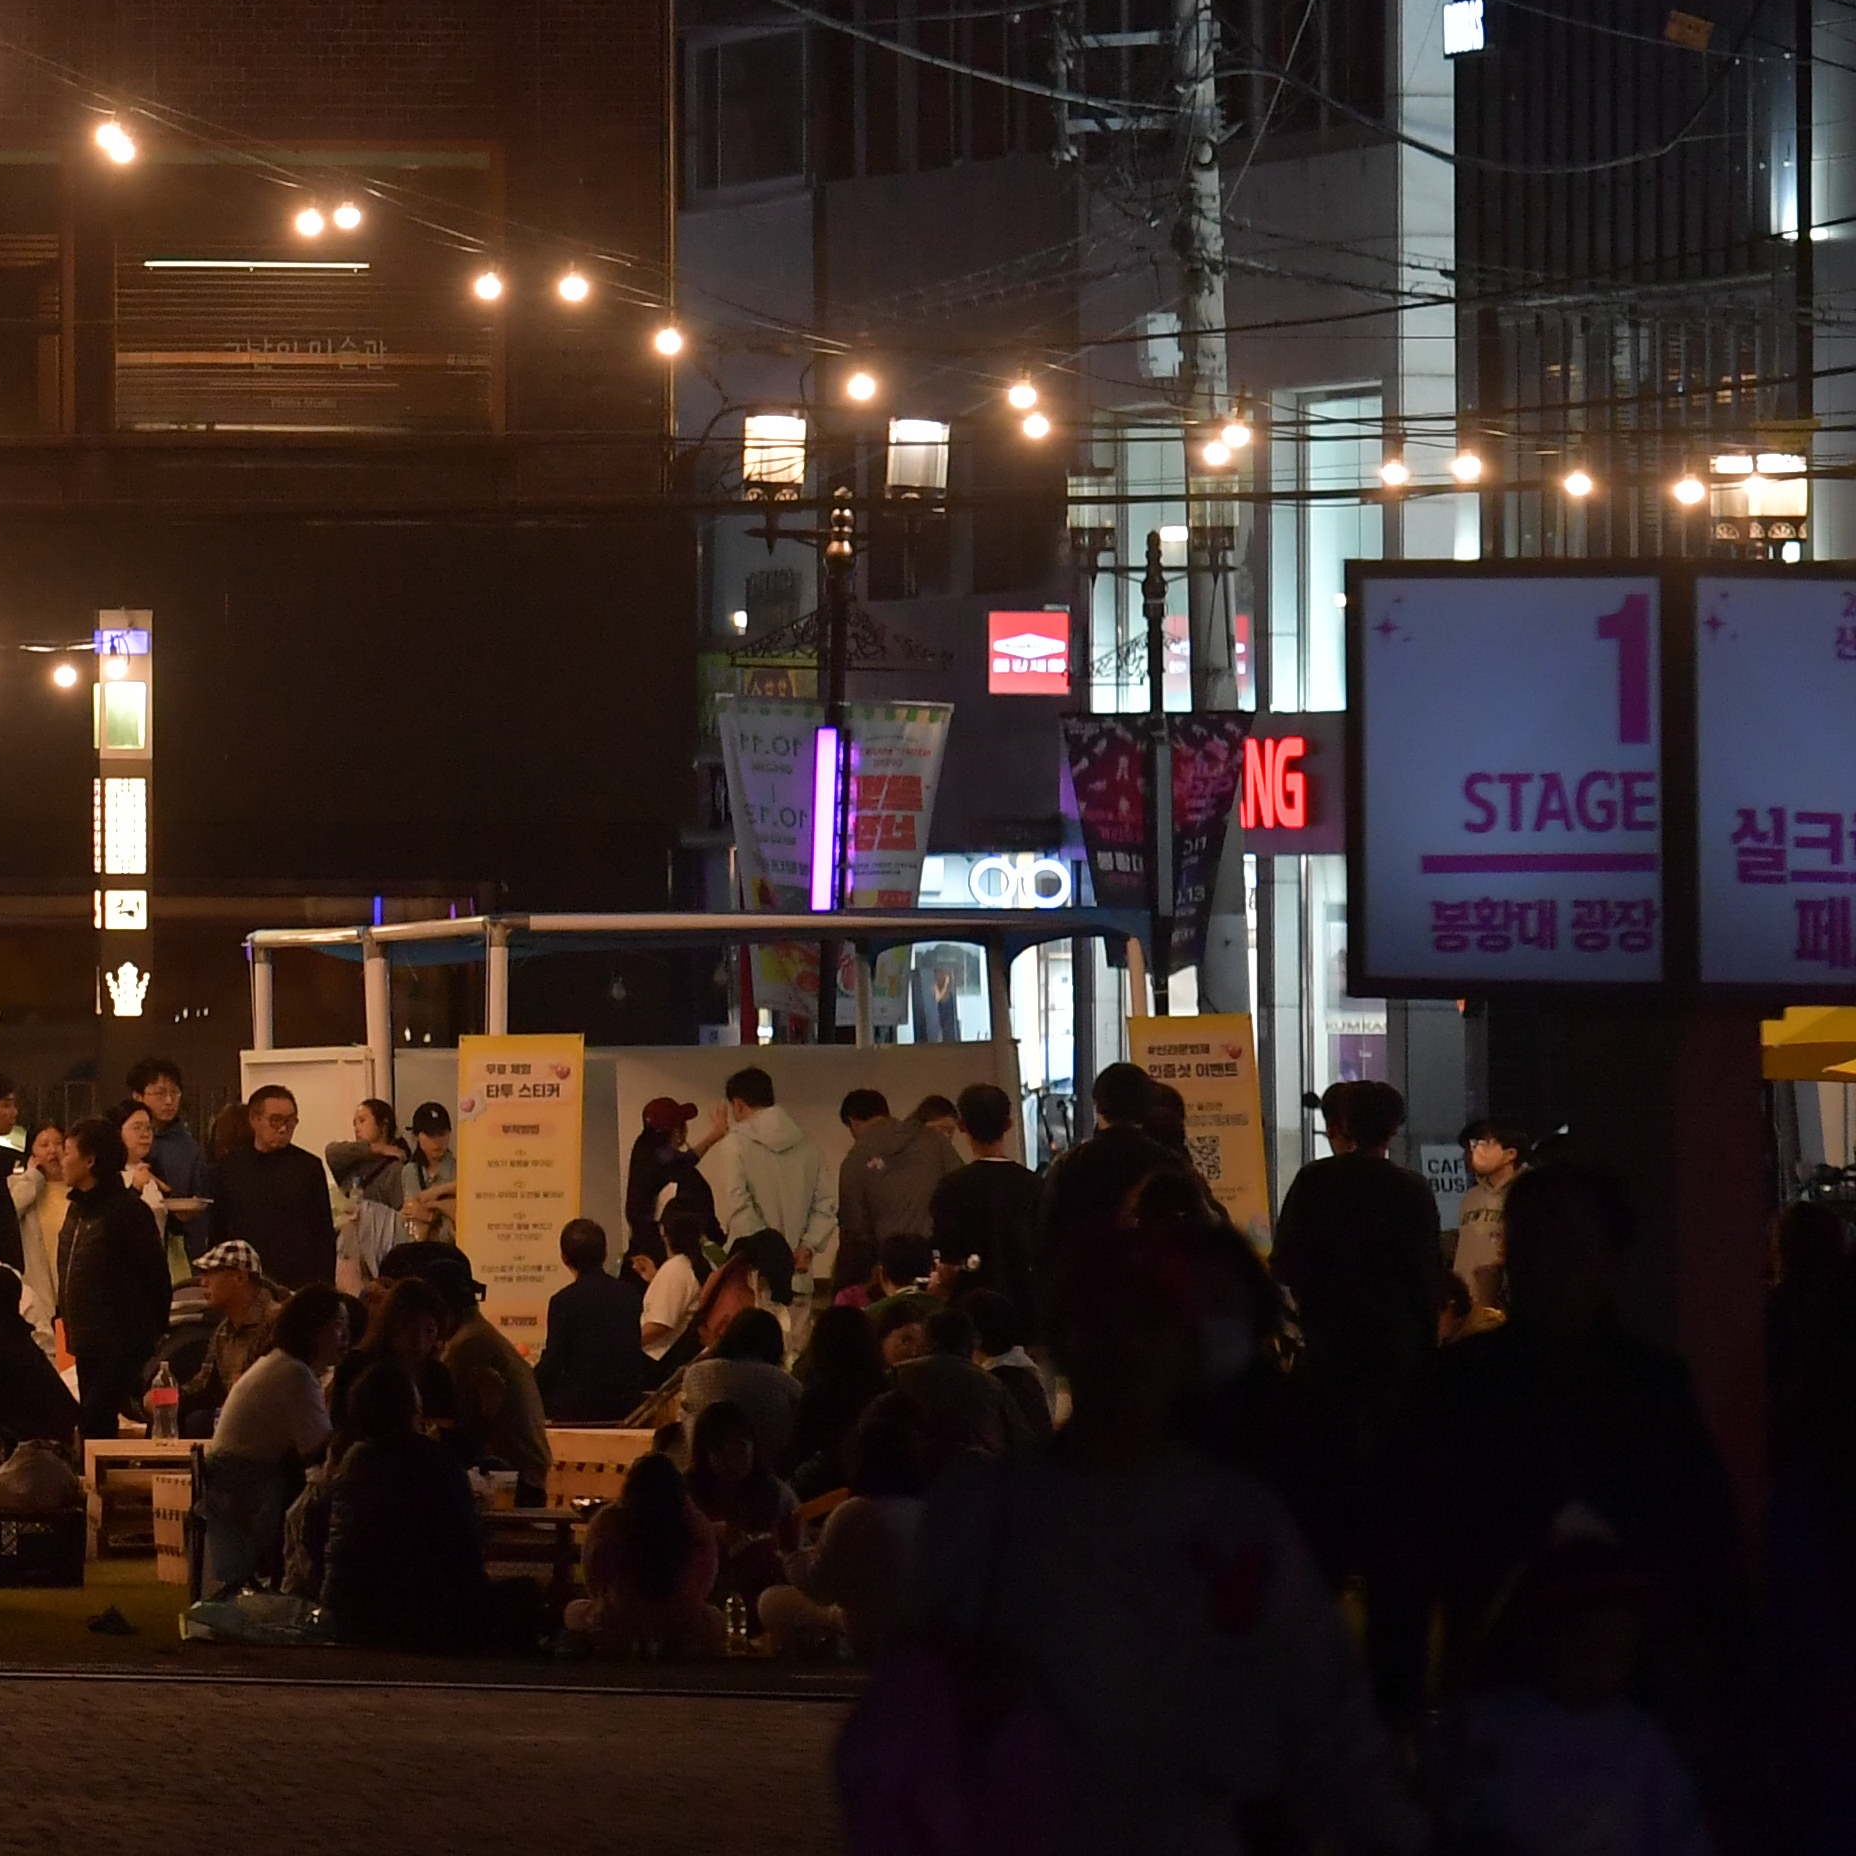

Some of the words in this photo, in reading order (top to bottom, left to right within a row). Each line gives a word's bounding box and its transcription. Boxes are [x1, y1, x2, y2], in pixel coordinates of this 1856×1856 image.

[1598, 593, 1650, 744] 1
[1240, 736, 1306, 830] NG
[1464, 770, 1656, 834] STAGE
[1732, 806, 1856, 885] 실크
[1431, 898, 1558, 954] 봉황대
[1571, 898, 1656, 954] 광장
[1795, 895, 1856, 969] 페
[1325, 1020, 1387, 1033] KUMKA
[486, 1083, 513, 1098] 타투
[519, 1082, 560, 1098] 스티커
[1148, 1063, 1191, 1079] 인증샷
[1195, 1061, 1238, 1077] 이벤트
